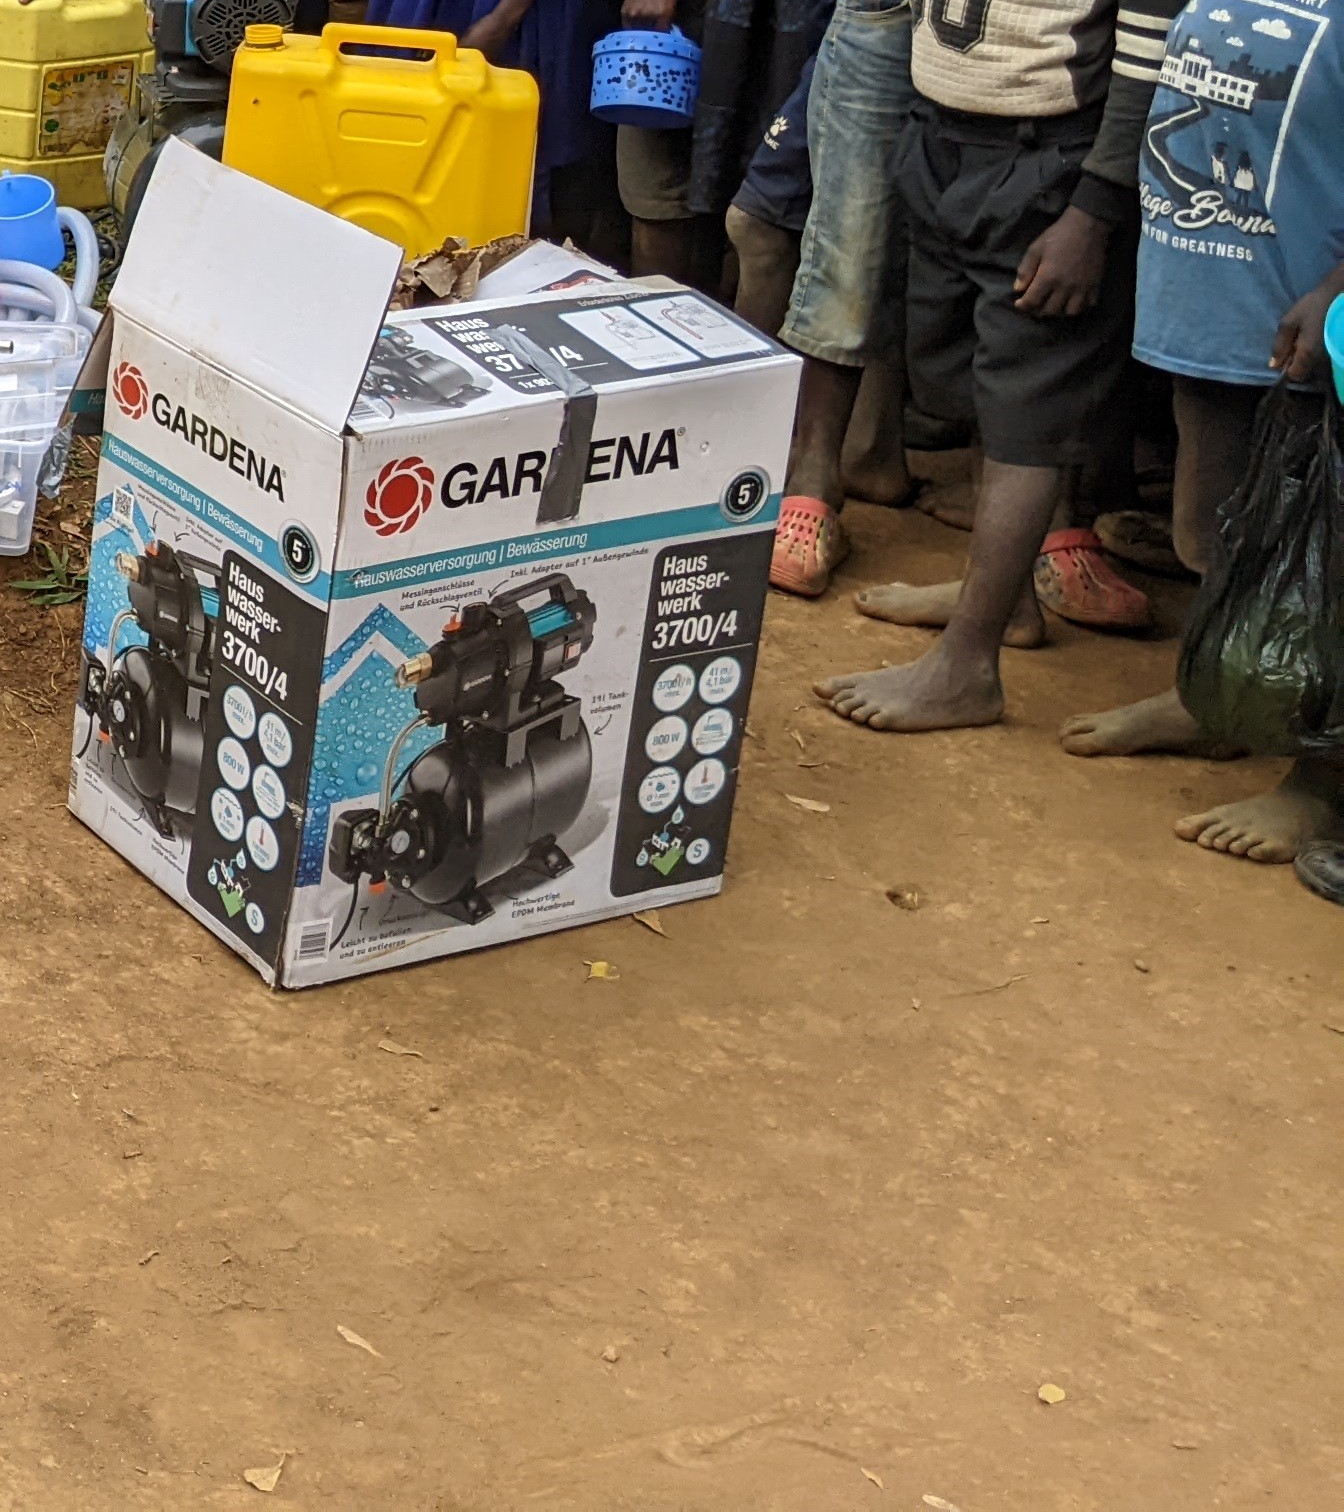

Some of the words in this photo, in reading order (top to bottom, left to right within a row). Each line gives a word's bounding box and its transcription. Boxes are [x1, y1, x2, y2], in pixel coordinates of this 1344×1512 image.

[435, 317, 490, 333] Haus
[152, 392, 285, 503] GARDENA
[440, 428, 681, 510] GARENA
[108, 440, 201, 511] Hauswasserversorgung
[207, 503, 264, 552] Bewässerung
[737, 483, 751, 505] 5
[292, 538, 303, 563] 5
[507, 532, 588, 559] Bewässerung
[228, 561, 265, 603] Haus
[532, 562, 563, 575] Adapter
[663, 554, 709, 578] Haus
[660, 573, 730, 597] wasser-
[226, 585, 282, 633] wasser-
[657, 591, 702, 616] werk
[225, 603, 261, 647] werk
[651, 610, 738, 650] 3700/4
[221, 635, 288, 701] 3700/4
